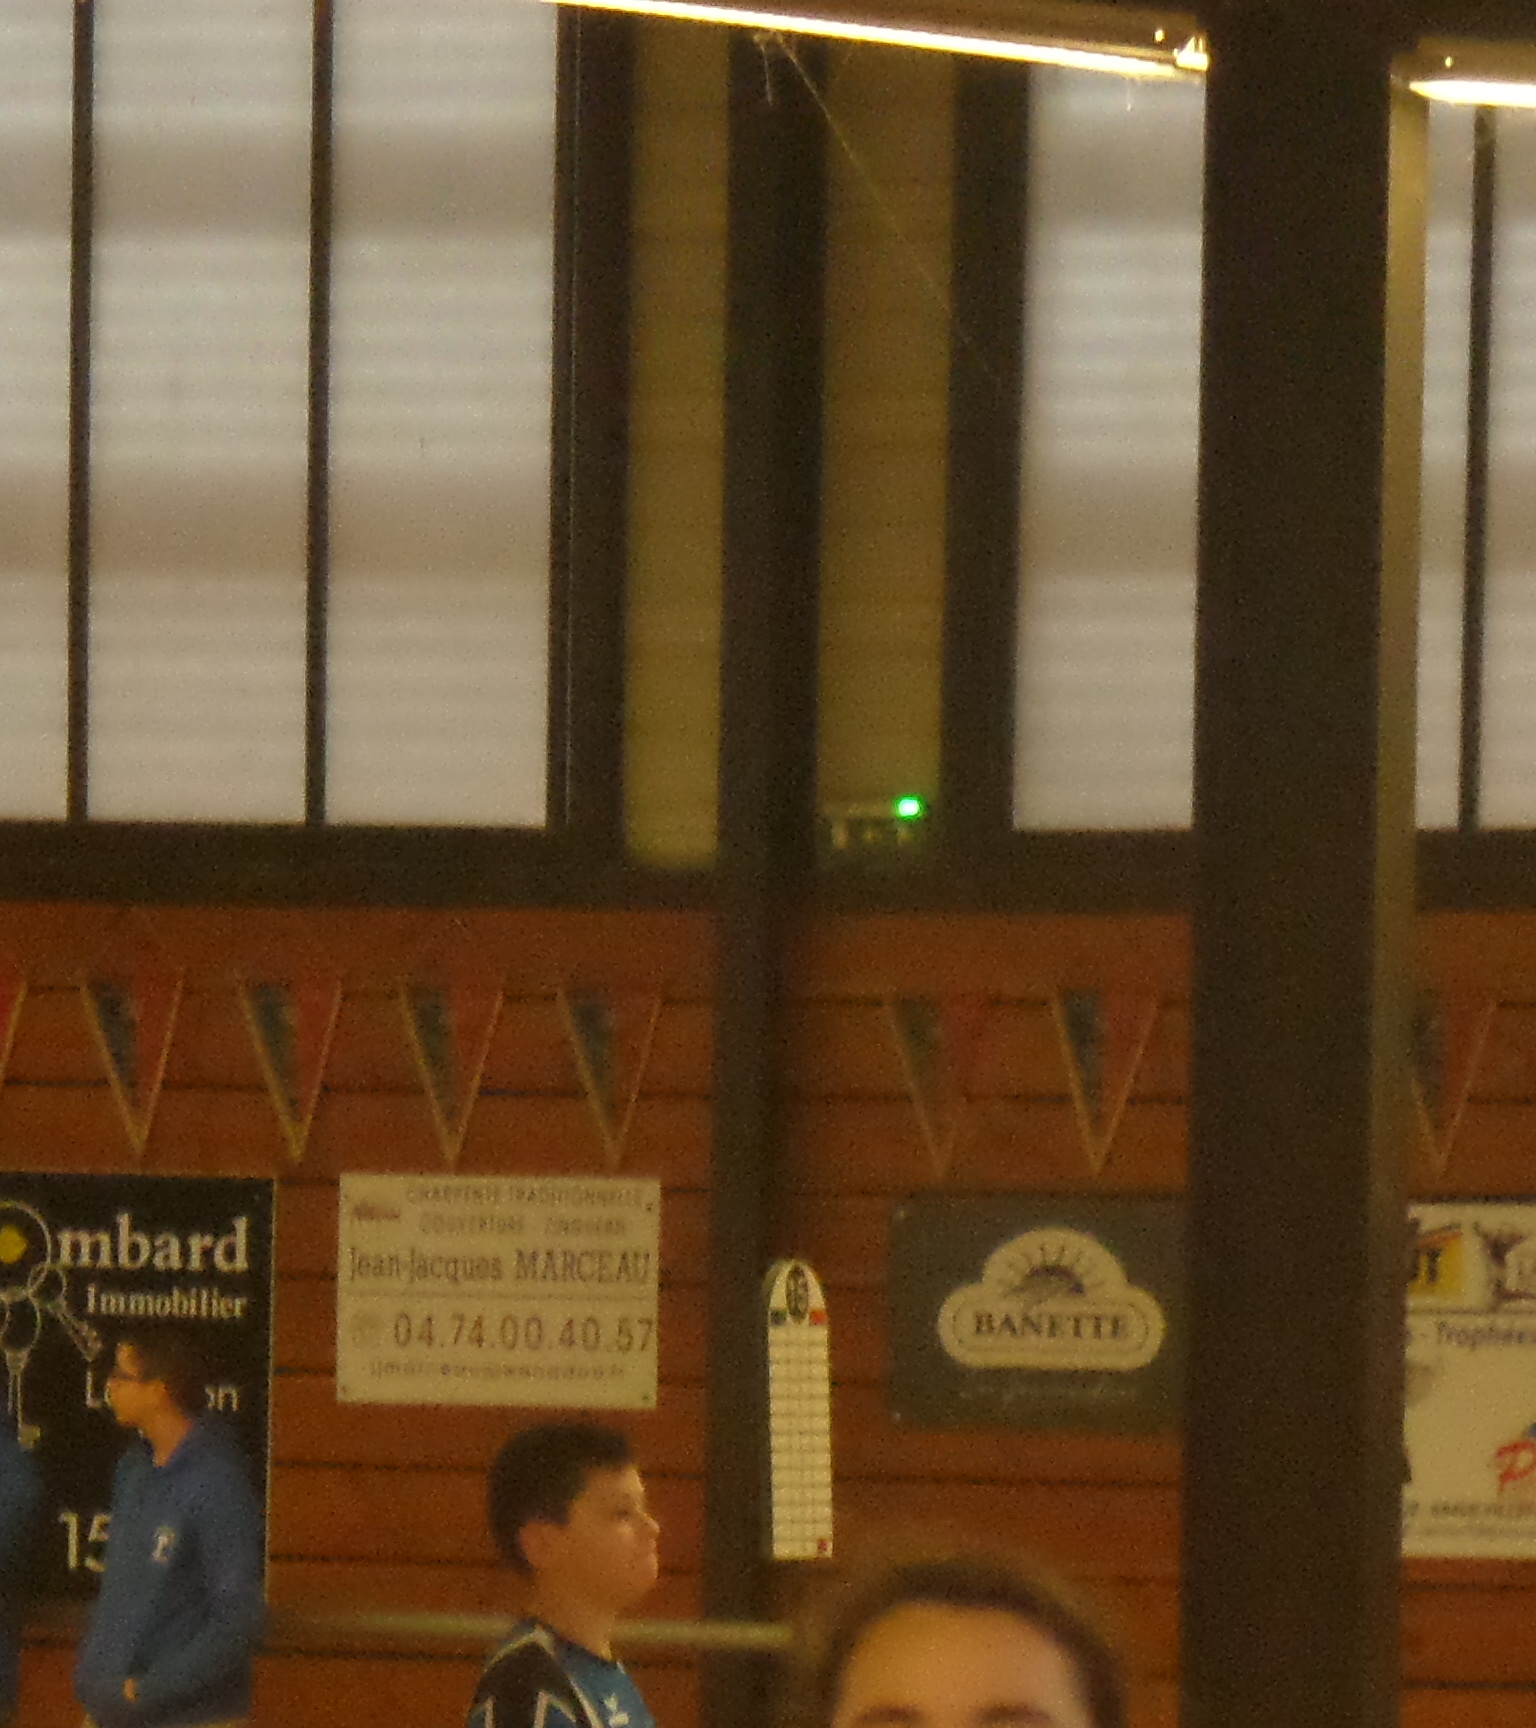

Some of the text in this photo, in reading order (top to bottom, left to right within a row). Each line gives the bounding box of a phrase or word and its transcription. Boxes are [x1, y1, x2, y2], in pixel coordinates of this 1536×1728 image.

[515, 1249, 652, 1284] MARCEAU
[86, 1284, 246, 1319] Immobilier
[973, 1311, 1130, 1340] BANETTE
